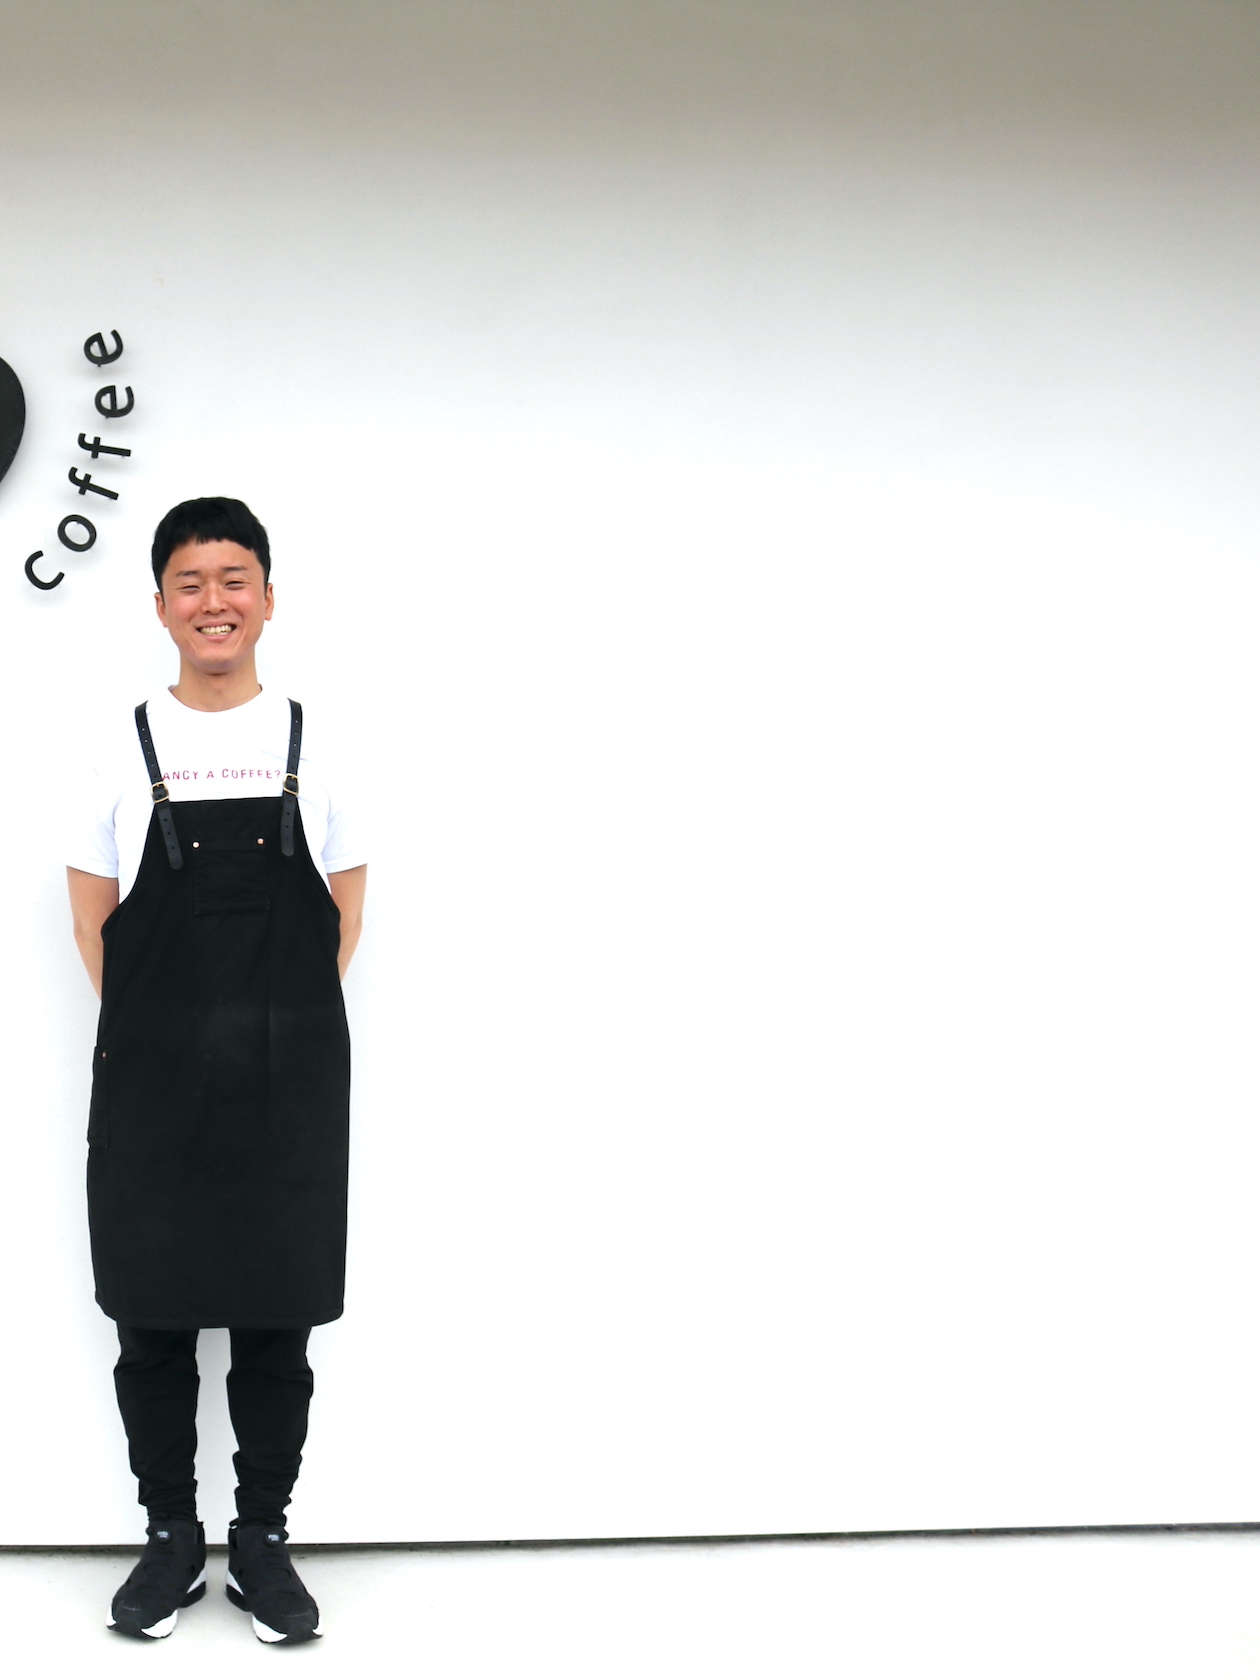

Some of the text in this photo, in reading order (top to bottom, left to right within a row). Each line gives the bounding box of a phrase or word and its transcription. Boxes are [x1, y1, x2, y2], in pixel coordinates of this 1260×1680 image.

[24, 329, 135, 591] coffee
[161, 768, 282, 781] ANCY A COFFEE?
